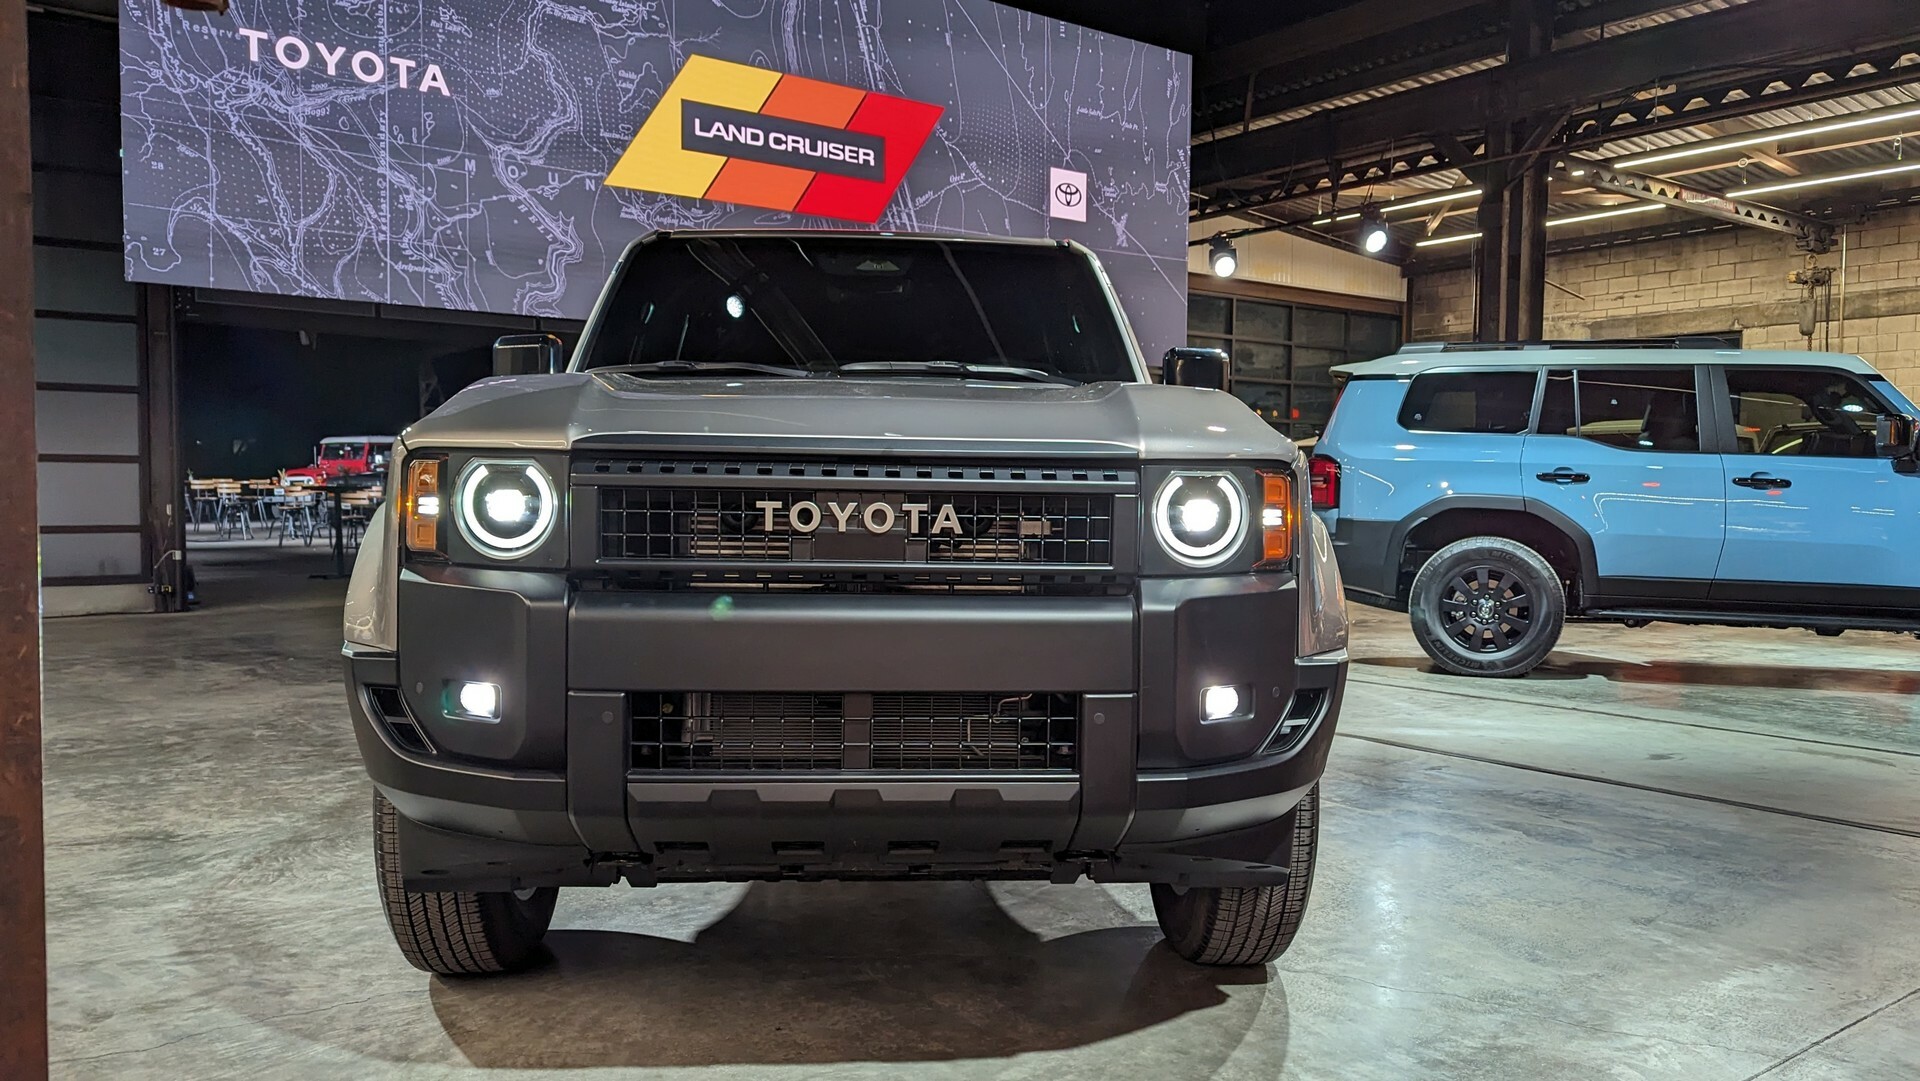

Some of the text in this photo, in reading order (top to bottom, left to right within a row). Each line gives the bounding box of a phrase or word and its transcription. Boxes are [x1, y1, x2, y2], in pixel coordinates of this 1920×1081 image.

[182, 20, 241, 41] Reserve
[239, 28, 451, 97] TOYOTA
[694, 118, 876, 167] LAND CRUISER
[152, 247, 167, 257] 27
[755, 500, 964, 535] TOYOTA
